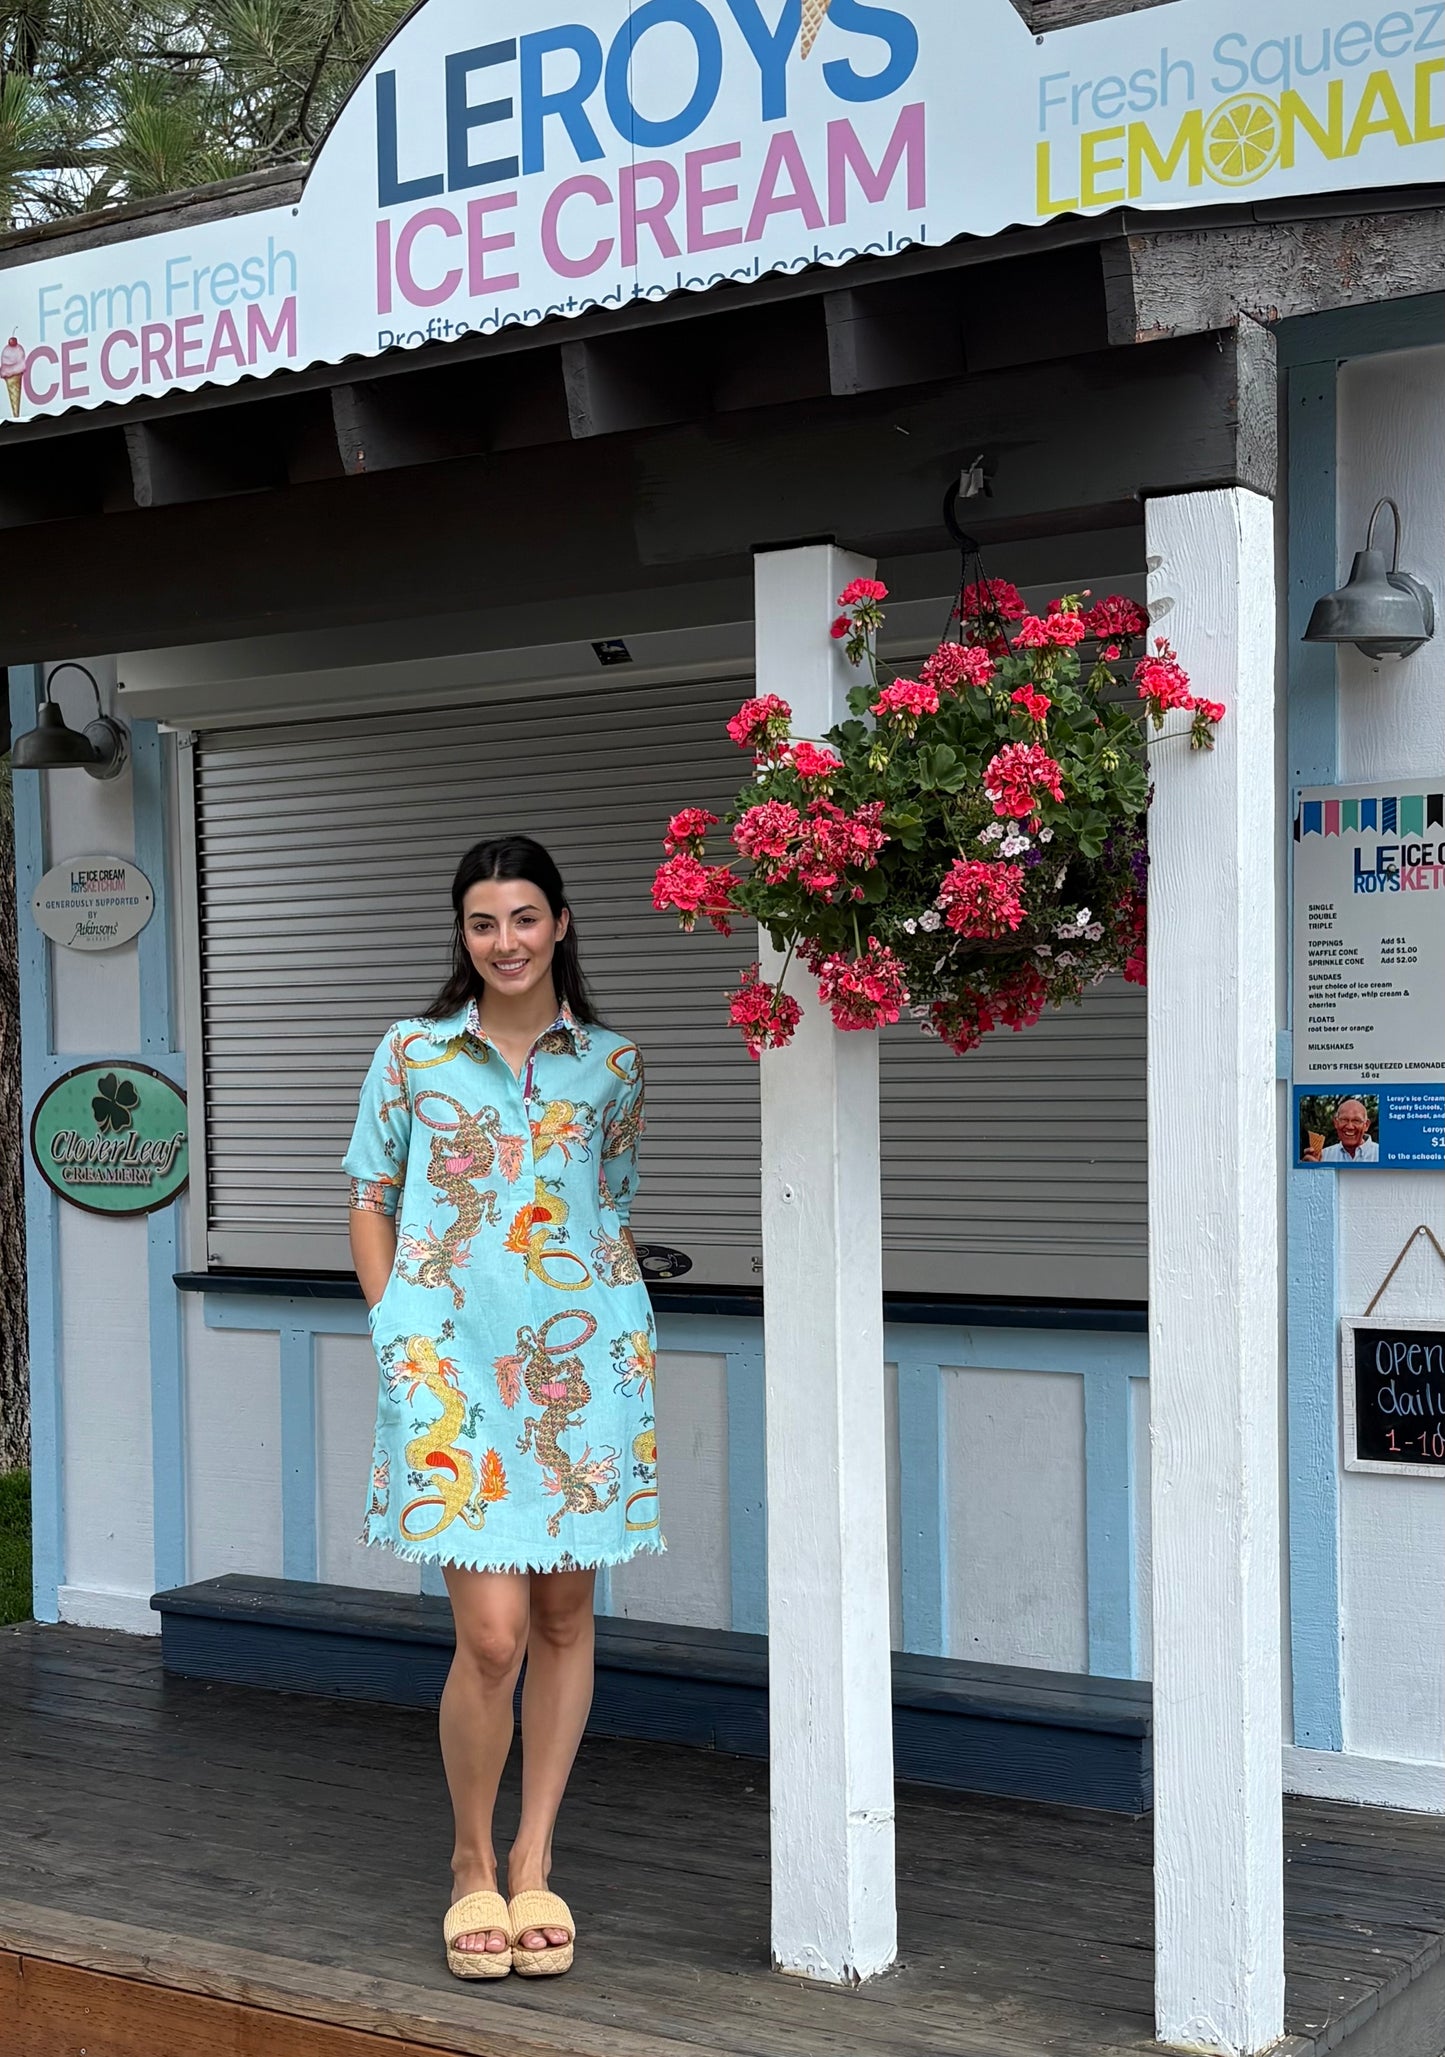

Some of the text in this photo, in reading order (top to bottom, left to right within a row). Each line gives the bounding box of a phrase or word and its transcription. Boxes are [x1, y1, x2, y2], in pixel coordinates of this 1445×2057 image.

[1038, 1, 1445, 132] Fresh Squeez
[376, 0, 919, 208] LEROYS
[376, 102, 926, 315] ICE CREAM
[38, 236, 297, 342] Farm Fresh
[100, 295, 297, 391] CREAM
[1401, 843, 1434, 867] ICE
[99, 868, 126, 881] CREAM
[1401, 865, 1445, 892] KET
[45, 896, 139, 909] GENEROUSLY SUPPORTED
[1308, 903, 1334, 911] SINGLE
[87, 911, 98, 919] BY
[1308, 912, 1337, 920] DOUBLE
[1308, 922, 1333, 930] TRIPLE
[1308, 949, 1337, 957] WAFFLE
[1338, 948, 1359, 956] CONE
[1396, 946, 1418, 954] $1.00
[1308, 958, 1344, 966] SPRINKLE
[1344, 957, 1365, 965] CONE
[1396, 955, 1418, 964] $2.00
[1308, 973, 1342, 981] SUNDAES
[1325, 982, 1347, 990] choice
[1338, 991, 1360, 999] fudge,
[1361, 990, 1378, 998] whip
[1403, 989, 1410, 997] &
[1308, 1001, 1337, 1009] cherries
[1349, 1025, 1375, 1033] orange
[1308, 1043, 1354, 1051] MILKSHAKES
[1308, 1063, 1338, 1071] LEROY'S
[1364, 1062, 1403, 1070] SQUEEZED
[1423, 1094, 1445, 1102] Cream
[1388, 1112, 1405, 1120] Sage
[61, 1166, 152, 1185] CREAMERY
